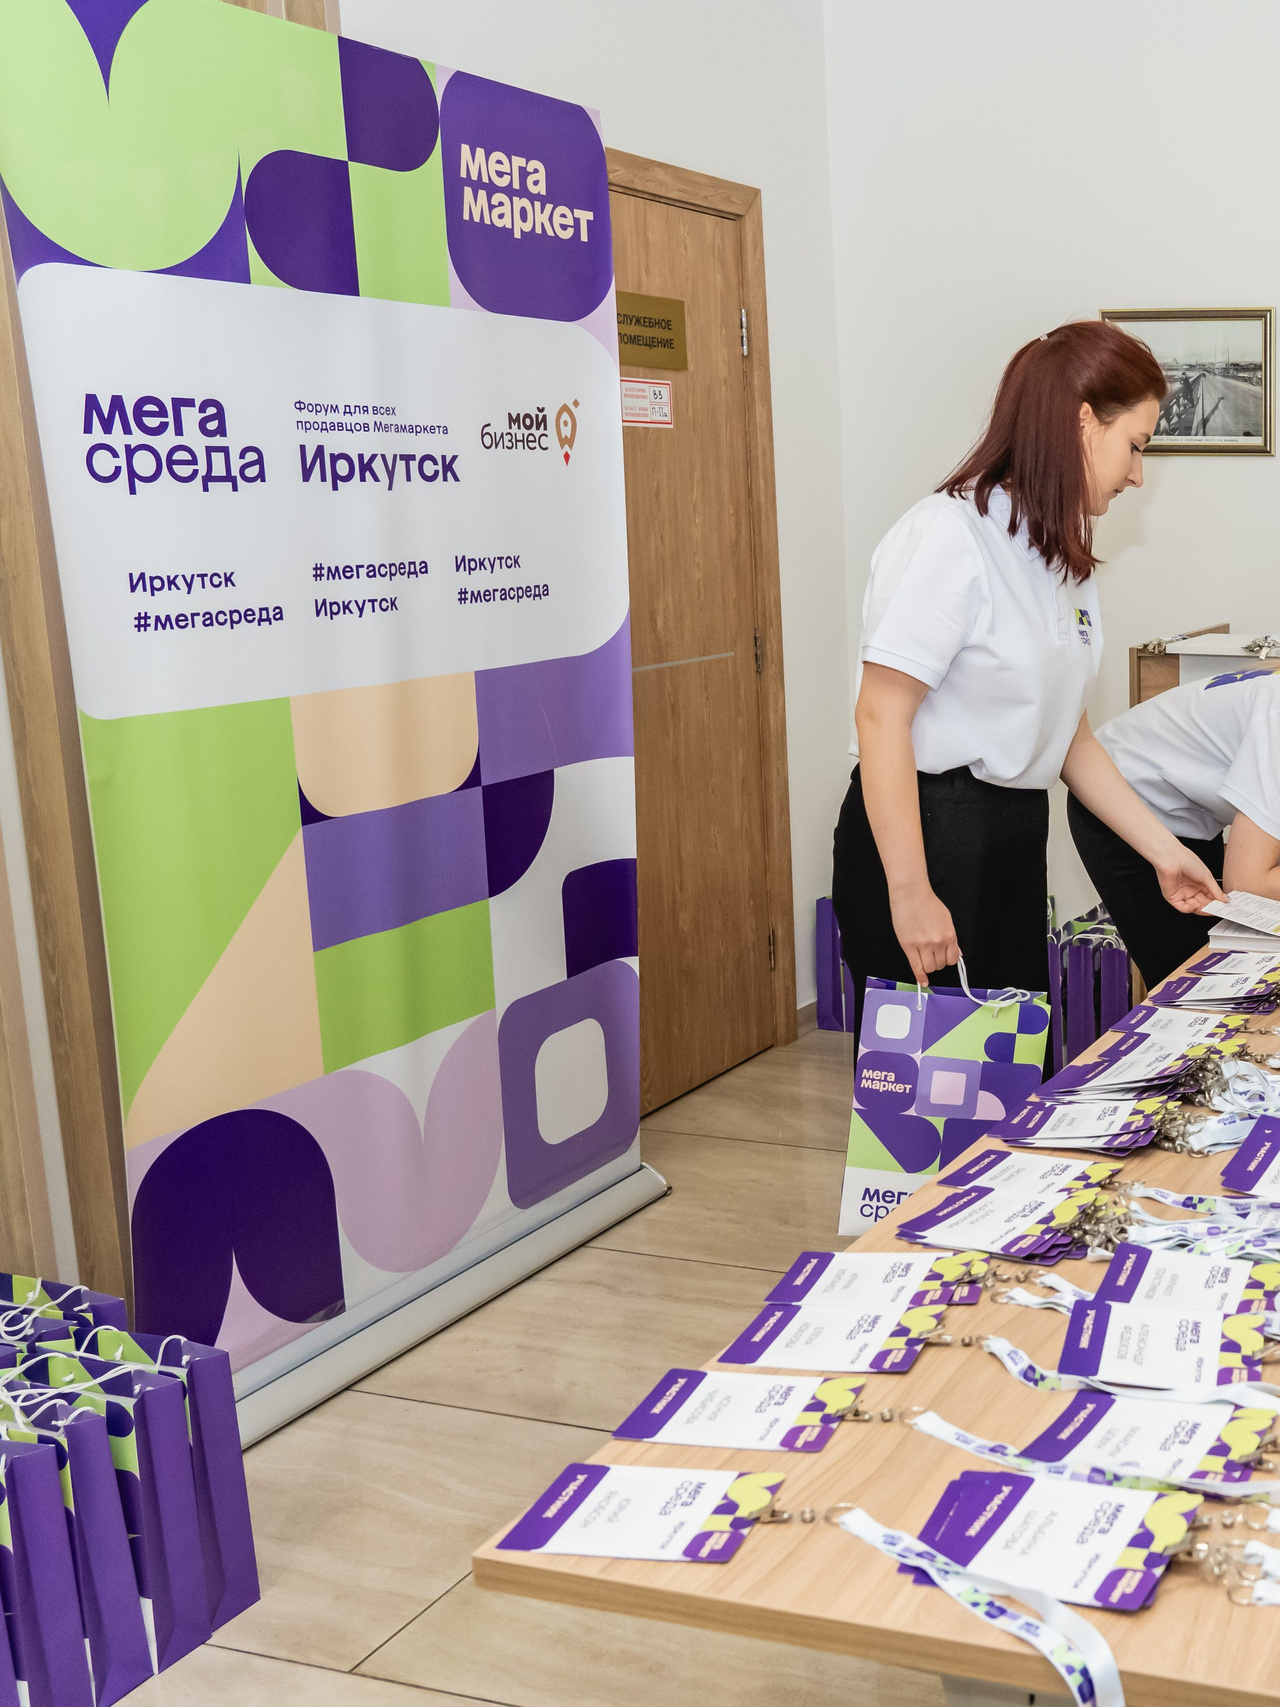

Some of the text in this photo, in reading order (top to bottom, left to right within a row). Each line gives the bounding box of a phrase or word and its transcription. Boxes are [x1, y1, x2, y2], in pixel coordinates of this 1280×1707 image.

[460, 143, 547, 197] мега
[462, 184, 594, 243] маркет
[616, 312, 672, 331] СЛУЖЕБНОЕ
[83, 393, 228, 438] мега
[294, 399, 397, 417] Форум для всех
[507, 406, 548, 431] мой
[296, 420, 449, 437] продавцов Мегамаркета
[480, 422, 549, 451] бизнес
[85, 442, 267, 496] среда
[299, 444, 461, 492] Иркутск
[312, 560, 429, 582] #мегасреда
[454, 554, 521, 576] Иркутск
[128, 571, 236, 597] Иркутск
[457, 583, 550, 605] #мегасреда
[133, 605, 284, 633] #мегасреда
[314, 596, 399, 620] Иркутск
[860, 1079, 912, 1095] маркет
[861, 1068, 895, 1082] мега
[966, 1154, 998, 1175] УЧАСТНИК
[1246, 1141, 1272, 1172] УЧАСТНИК
[861, 1187, 914, 1205] мег
[935, 1192, 979, 1217] УЧАСТНИК
[792, 1258, 819, 1286] УЧАСТНИК
[882, 1262, 908, 1284] среда
[897, 1262, 914, 1278] мега
[1116, 1253, 1137, 1287] УЧАСТНИК
[1204, 1266, 1222, 1289] среда
[1217, 1267, 1232, 1284] мега
[750, 1311, 784, 1342] УЧАСТНИК
[845, 1314, 872, 1340] среда
[862, 1315, 882, 1333] мега
[1079, 1309, 1097, 1349] УЧАСТНИК
[1175, 1319, 1190, 1352] среда
[1189, 1321, 1201, 1344] мега
[650, 1377, 688, 1415] УЧАСТНИК
[754, 1385, 784, 1414] среда
[773, 1385, 796, 1406] мега
[1057, 1402, 1097, 1441] УЧАСТНИК
[1178, 1422, 1202, 1445] мега
[1159, 1420, 1190, 1452] среда
[542, 1474, 588, 1519] УЧАСТНИК
[658, 1480, 693, 1516] среда
[680, 1482, 707, 1507] мега
[965, 1485, 1013, 1537] УЧАСТНИК
[1075, 1501, 1113, 1545] среда
[1097, 1504, 1125, 1535] мега
